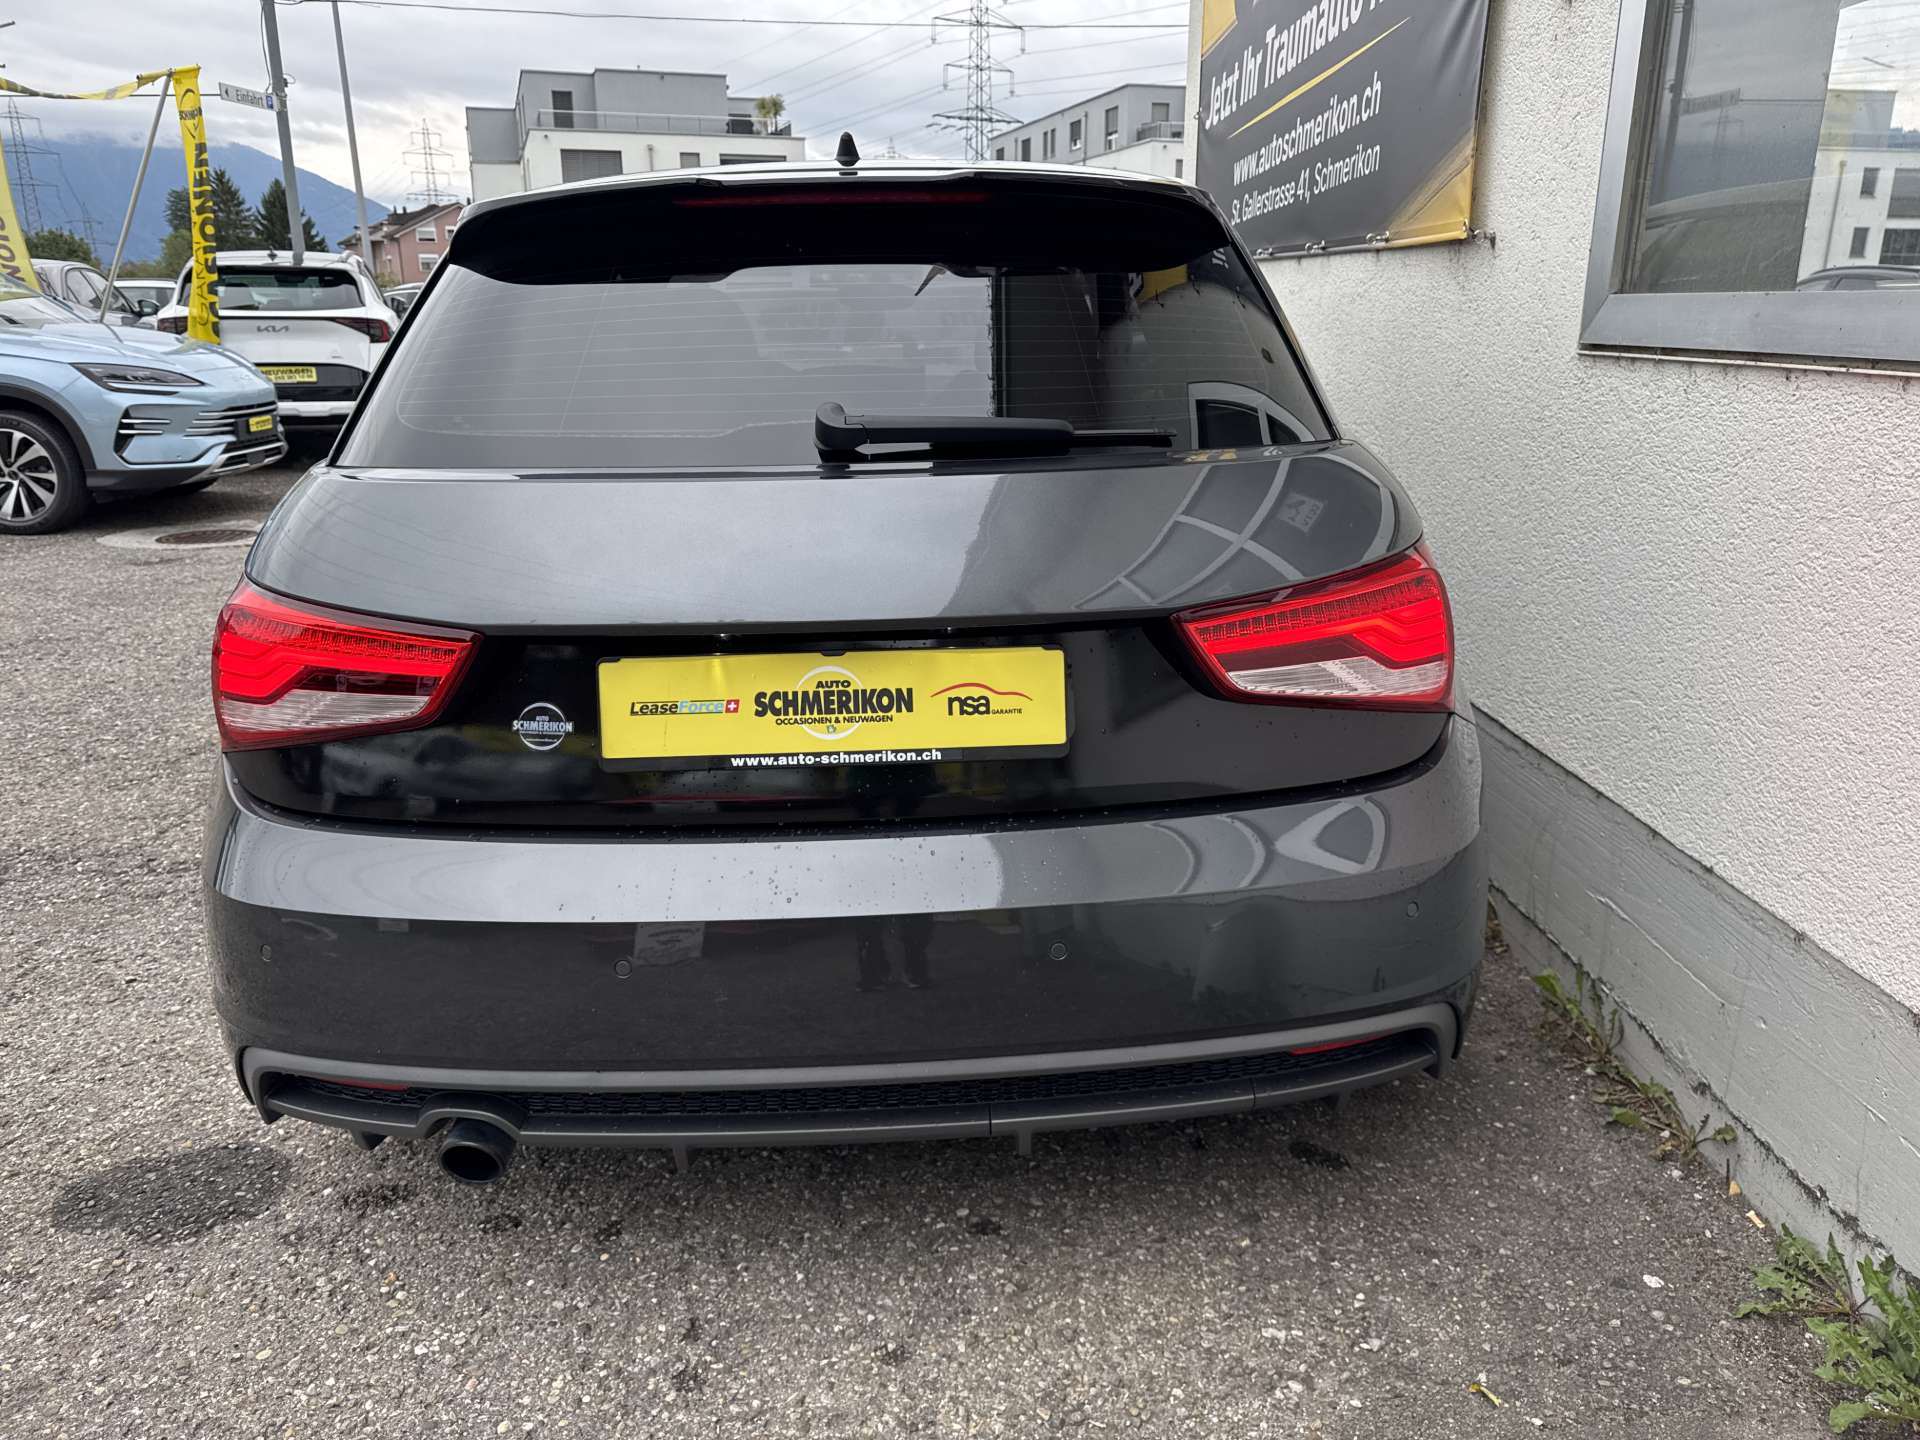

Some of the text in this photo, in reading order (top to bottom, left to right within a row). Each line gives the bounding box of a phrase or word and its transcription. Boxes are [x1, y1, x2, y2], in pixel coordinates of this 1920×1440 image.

[1205, 0, 1363, 130] Jetzt Ihr Traumauto
[1233, 70, 1381, 186] www.autoschmerikon.ch
[1231, 199, 1241, 226] St.
[1242, 181, 1295, 221] Gallerstrasse
[1313, 144, 1380, 195] Schmerikon
[815, 679, 851, 689] AUTO
[630, 700, 724, 716] LeaseForce
[754, 687, 914, 718] SCHMERIKON
[947, 695, 1023, 716] nsa GARANTIE
[512, 720, 573, 733] SCHMERIKON
[775, 716, 832, 726] OCCASIONEN
[843, 715, 893, 724] NEUWAGEN
[731, 748, 942, 767] www.auto-schmerikon.ch
